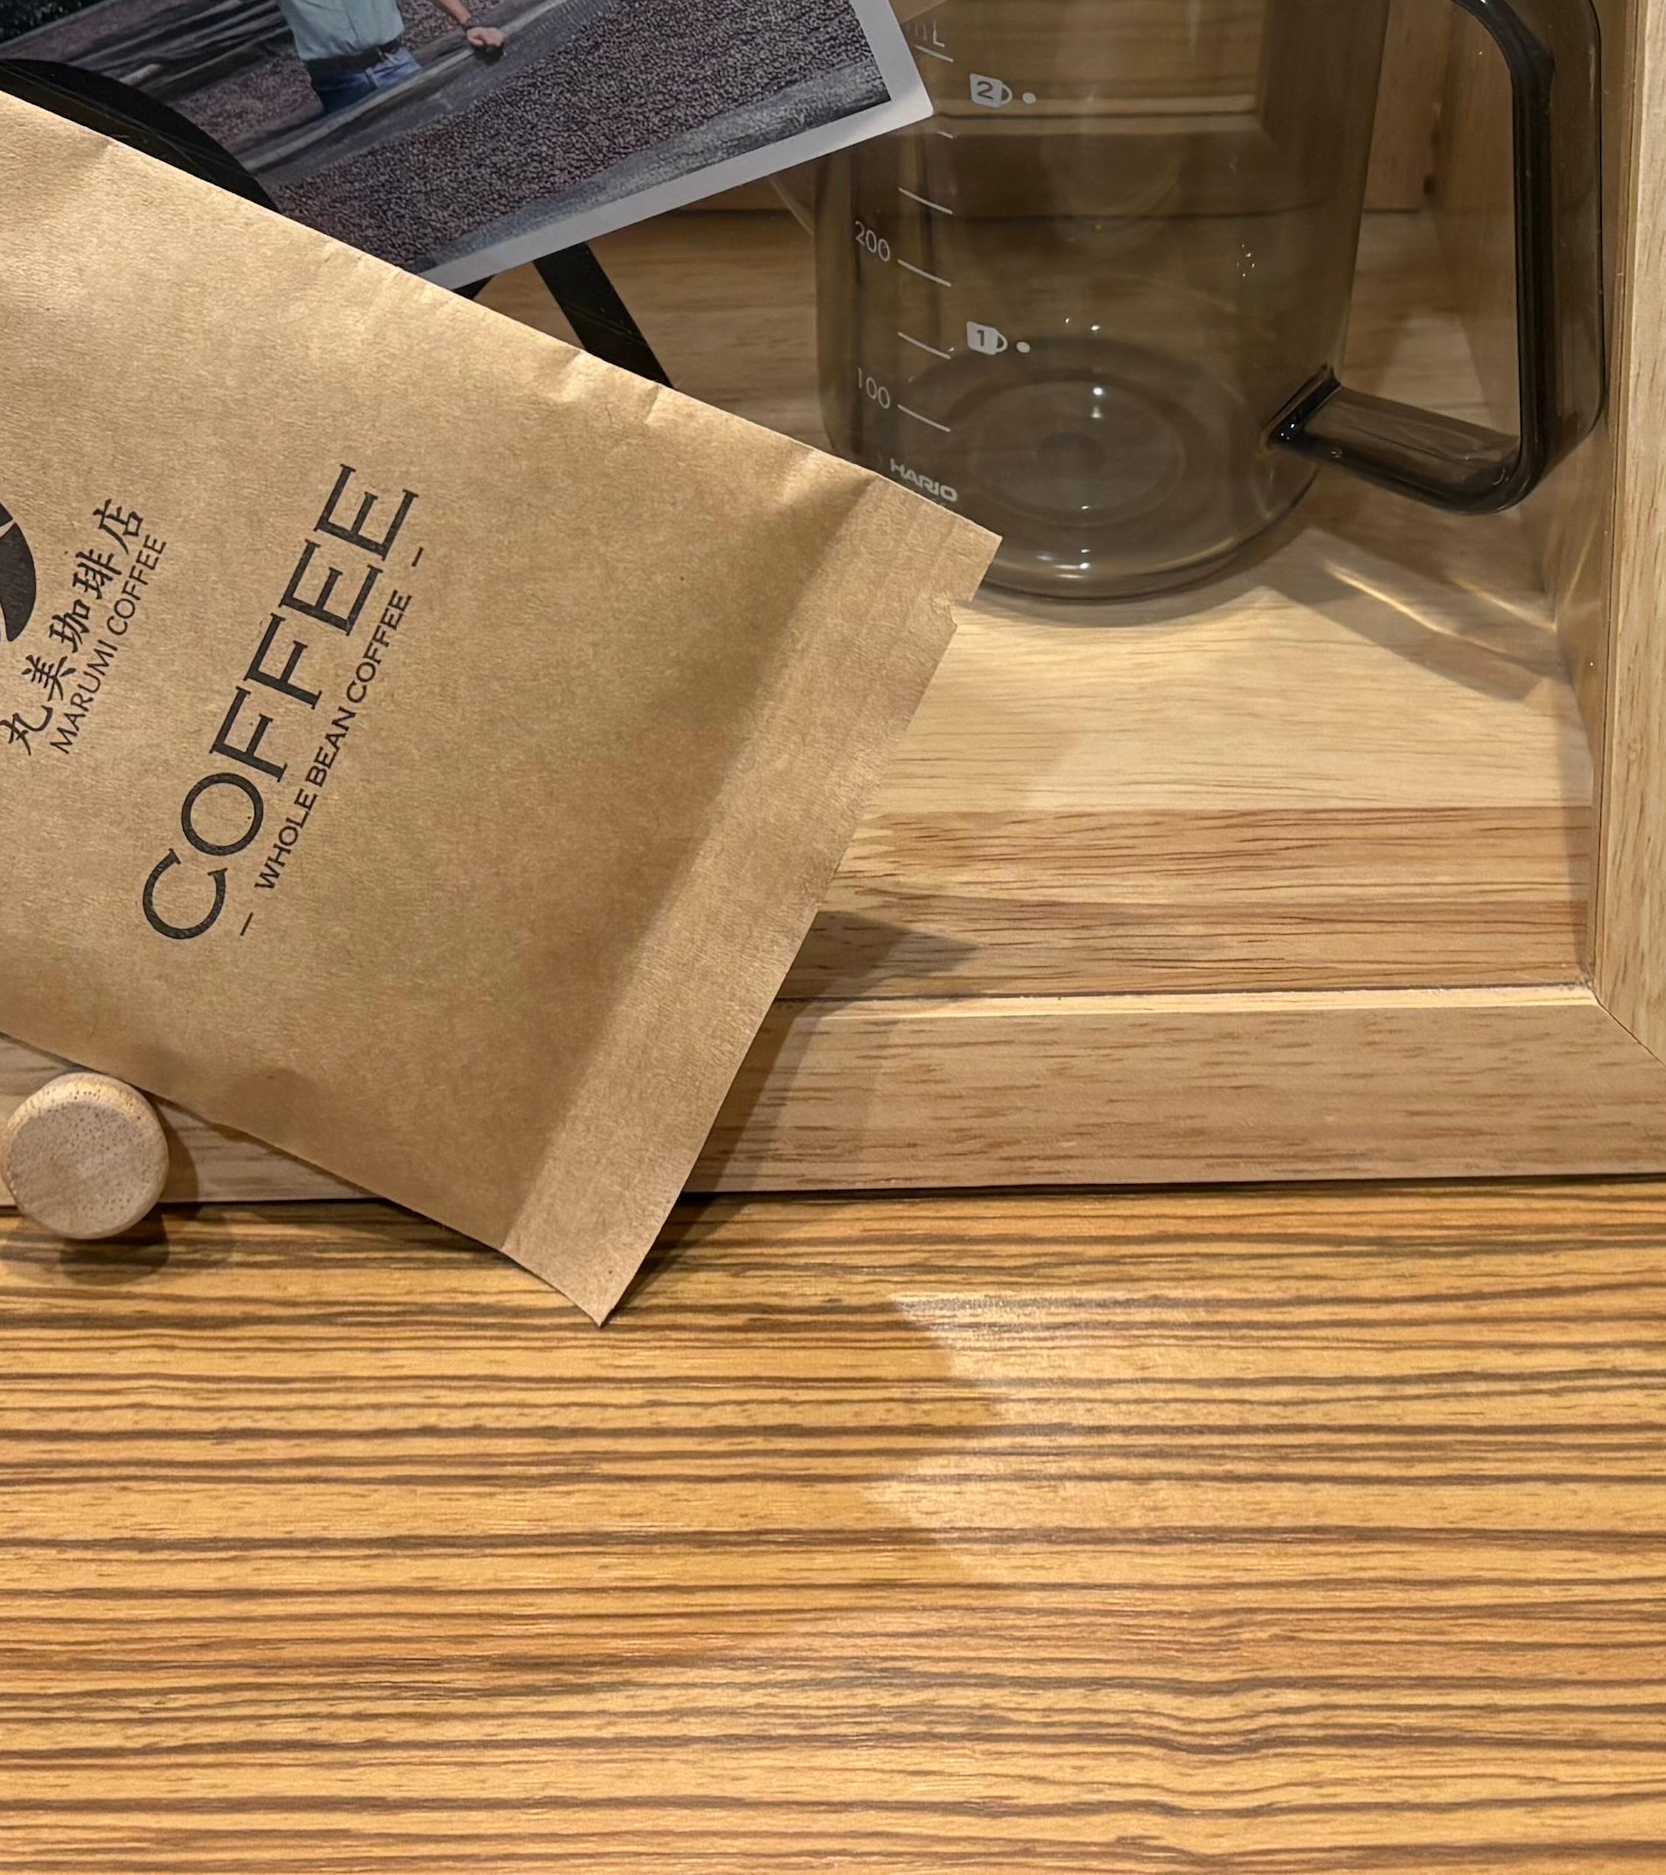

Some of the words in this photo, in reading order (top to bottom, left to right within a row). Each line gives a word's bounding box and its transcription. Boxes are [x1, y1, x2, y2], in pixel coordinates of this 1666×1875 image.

[855, 220, 891, 262] 200
[857, 367, 891, 409] 100
[889, 457, 959, 503] HARIO
[0, 498, 144, 757] 丸美珈琲店
[49, 638, 118, 755] MARUMI
[106, 533, 167, 636] COFFEE
[141, 463, 420, 941] COFFEE
[253, 787, 319, 891] WHOLE
[305, 705, 357, 788] BEAN
[346, 588, 414, 704] COFFEE
